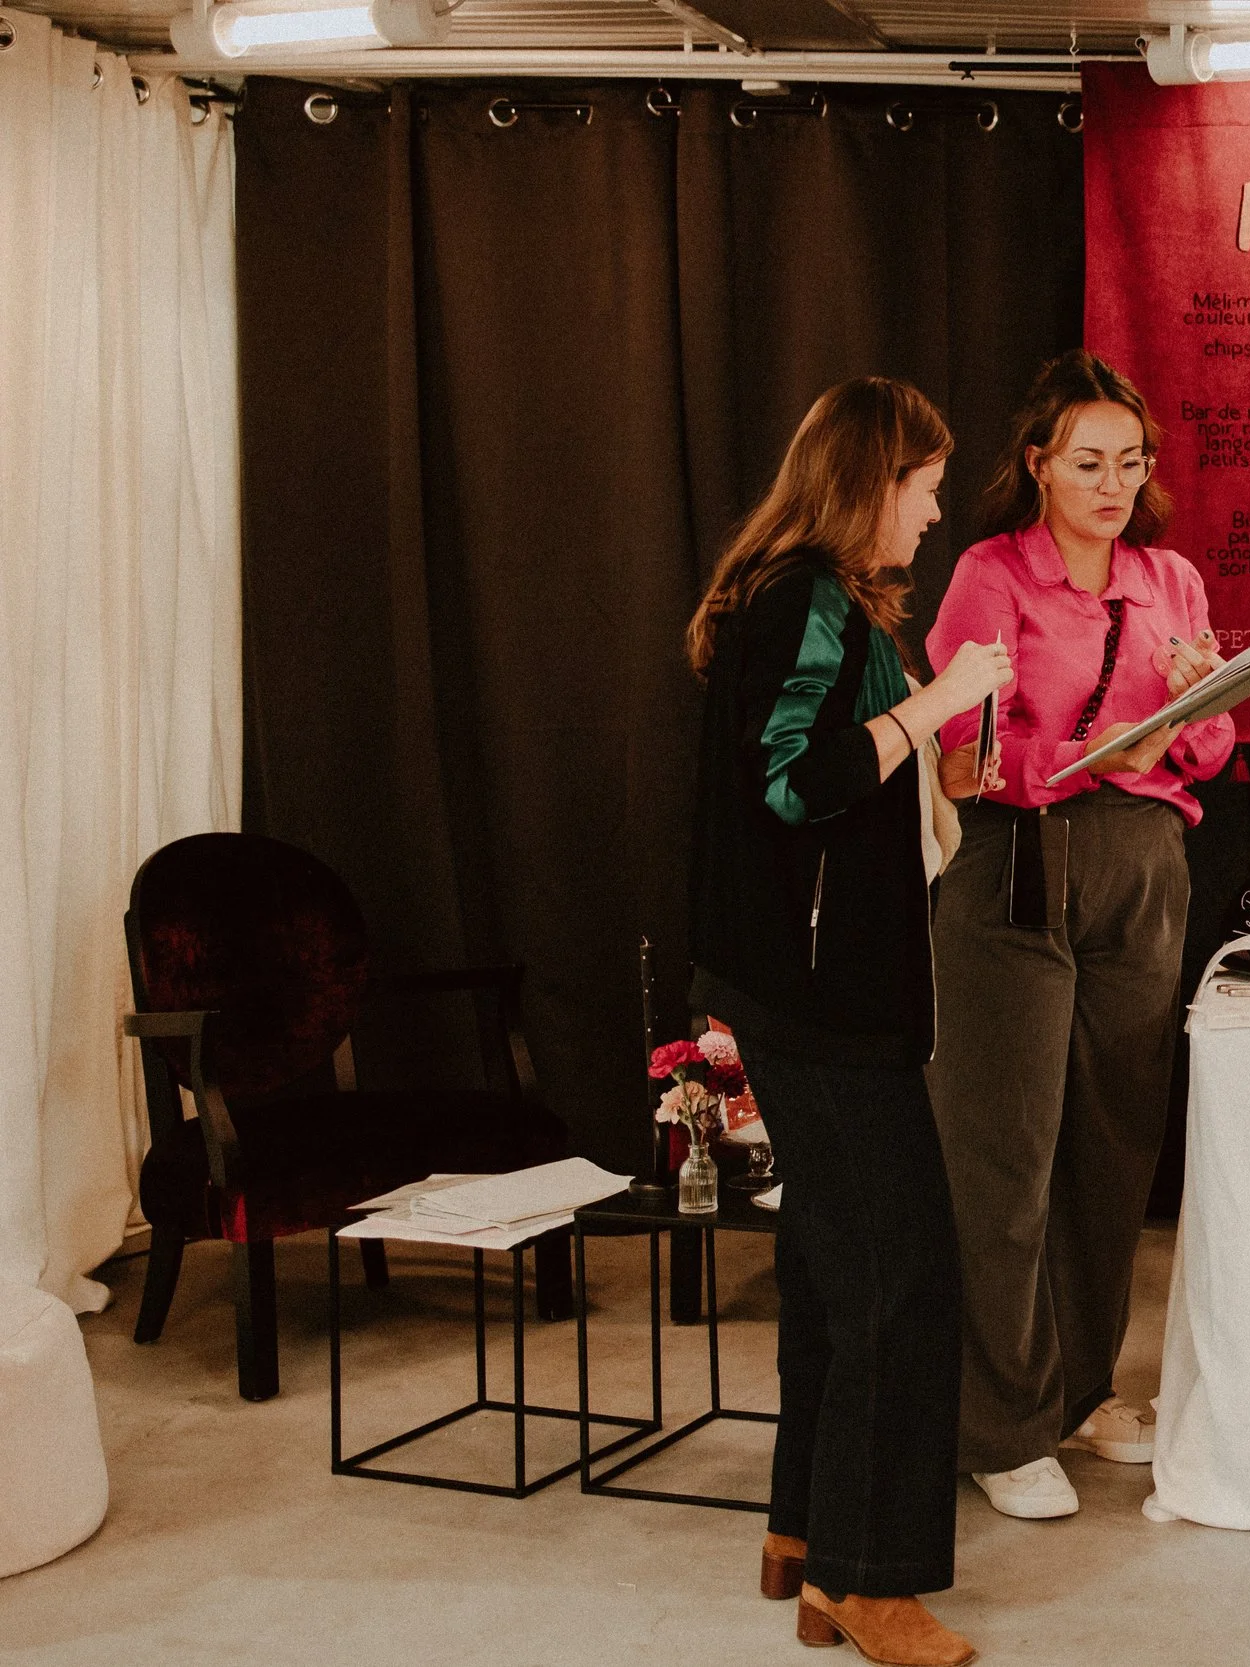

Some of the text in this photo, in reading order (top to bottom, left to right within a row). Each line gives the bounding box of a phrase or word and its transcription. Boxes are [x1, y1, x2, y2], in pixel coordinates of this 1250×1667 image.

[1181, 400, 1211, 421] Bar
[1218, 402, 1240, 420] de
[1197, 421, 1236, 438] noir,
[1200, 451, 1250, 471] petits
